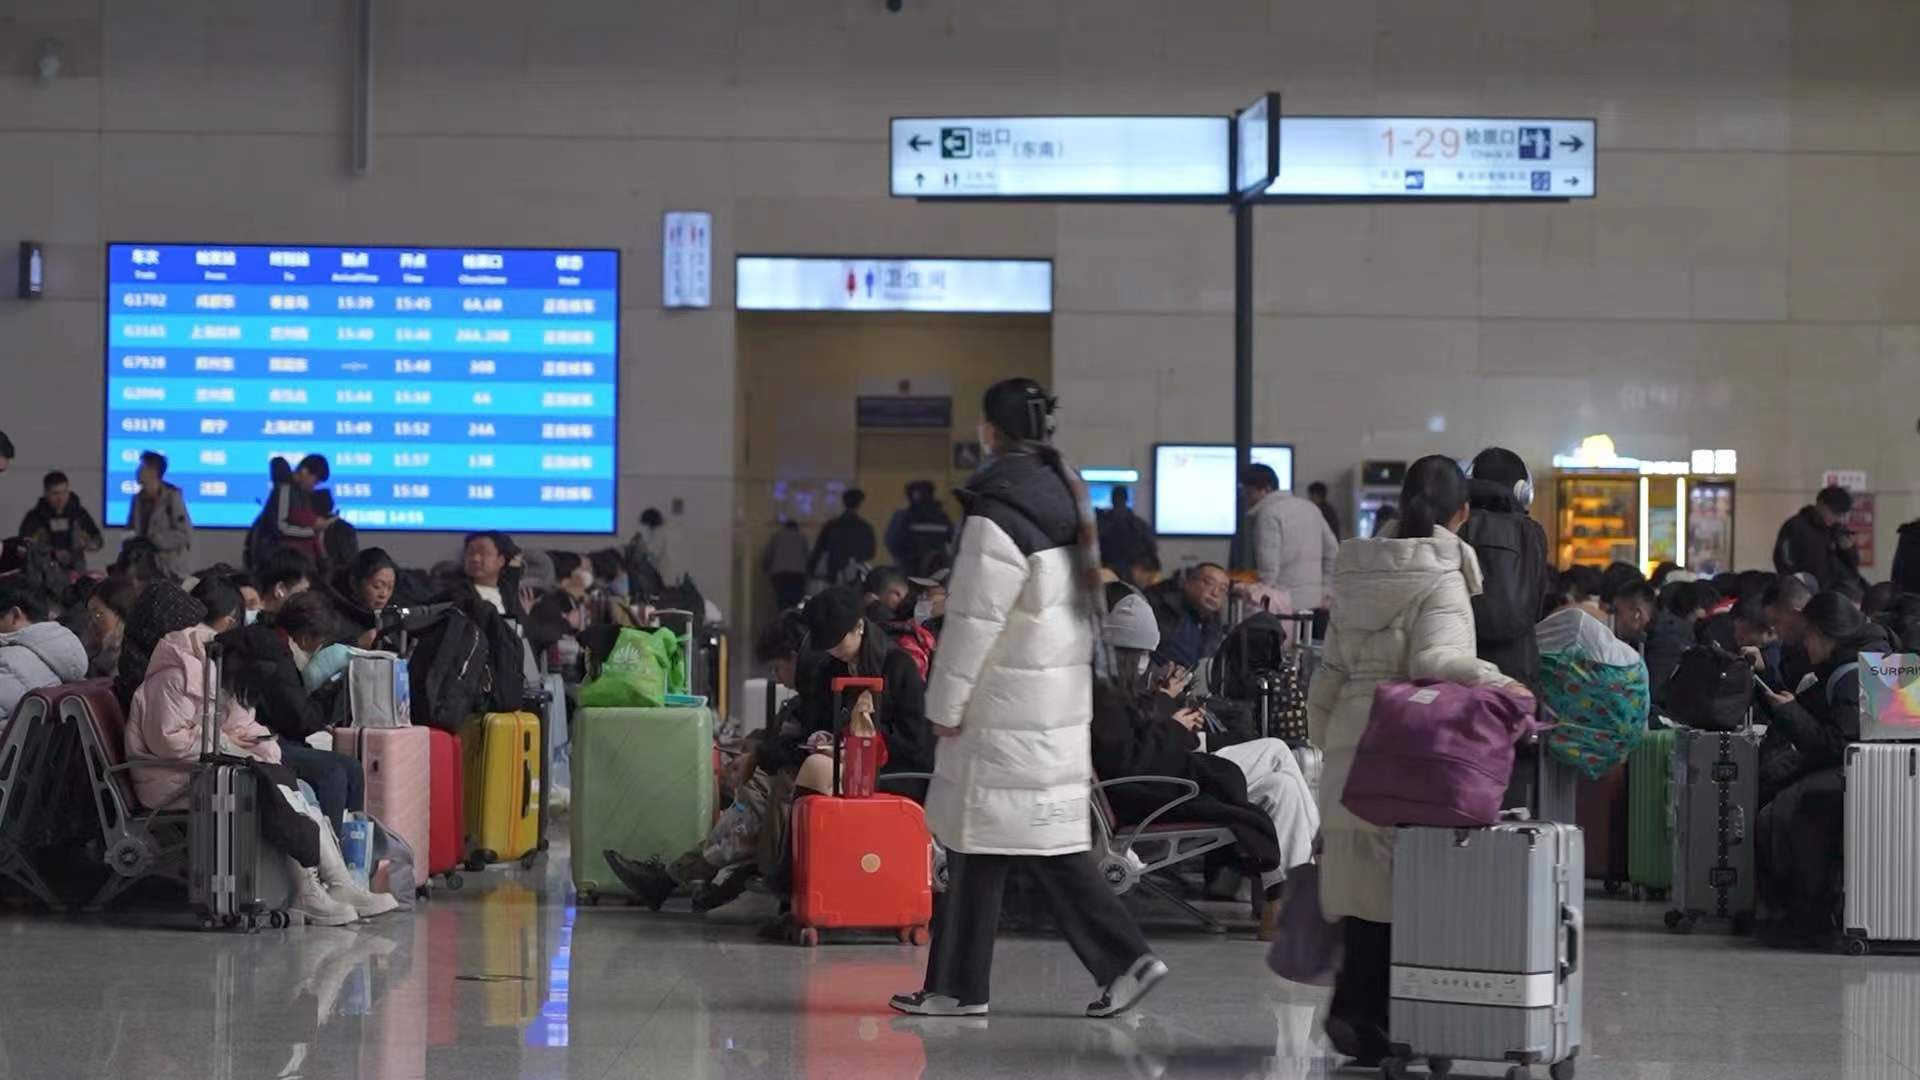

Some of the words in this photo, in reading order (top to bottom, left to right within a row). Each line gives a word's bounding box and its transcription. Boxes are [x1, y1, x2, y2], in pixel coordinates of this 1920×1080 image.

[976, 128, 1010, 145] 出口
[1381, 127, 1460, 158] 1-29
[1465, 128, 1515, 145] 检票口
[885, 269, 945, 288] 卫生间
[1870, 665, 1920, 676] SURPRI
